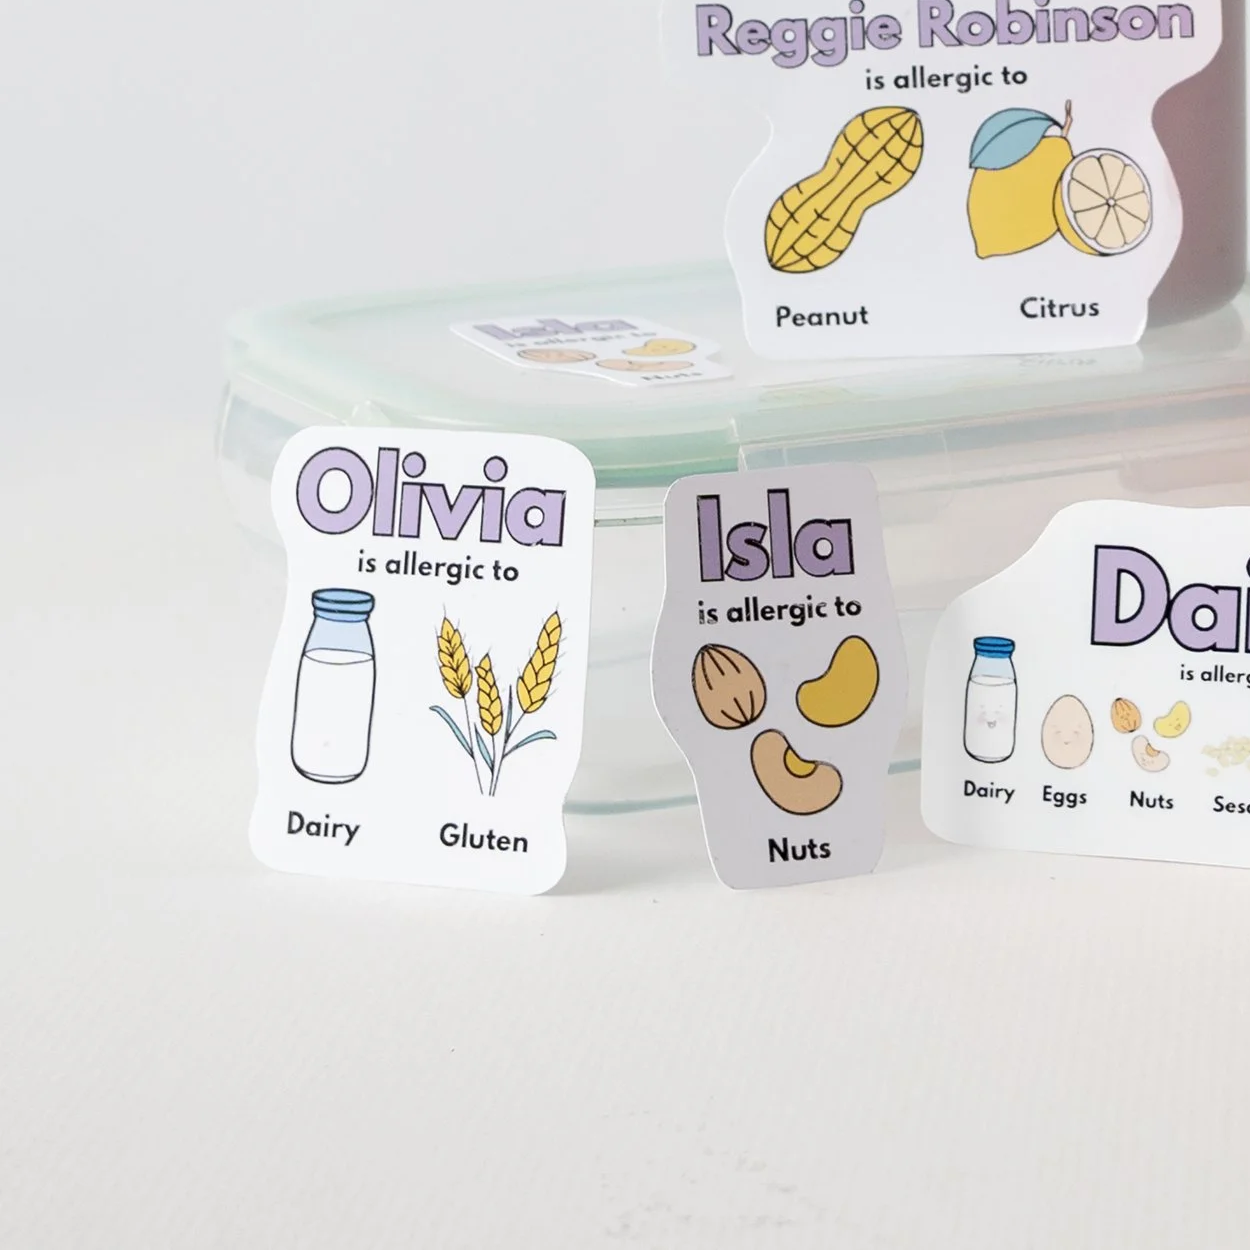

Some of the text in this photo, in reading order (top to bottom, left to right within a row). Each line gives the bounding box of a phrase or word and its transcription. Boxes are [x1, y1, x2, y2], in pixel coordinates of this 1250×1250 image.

[866, 64, 1028, 94] is allergic to
[776, 305, 869, 328] Peanut
[1019, 296, 1100, 319] Citrus
[295, 446, 567, 548] Olivia
[696, 487, 856, 583] Isla
[358, 548, 520, 586] is allergic to
[697, 594, 862, 627] is allergic to
[1180, 663, 1195, 681] is
[963, 779, 1016, 805] Dairy
[1042, 784, 1087, 809] Eggs
[1129, 790, 1174, 810] Nuts
[287, 810, 361, 847] Dairy
[439, 822, 528, 853] Gluten
[767, 837, 832, 863] Nuts
